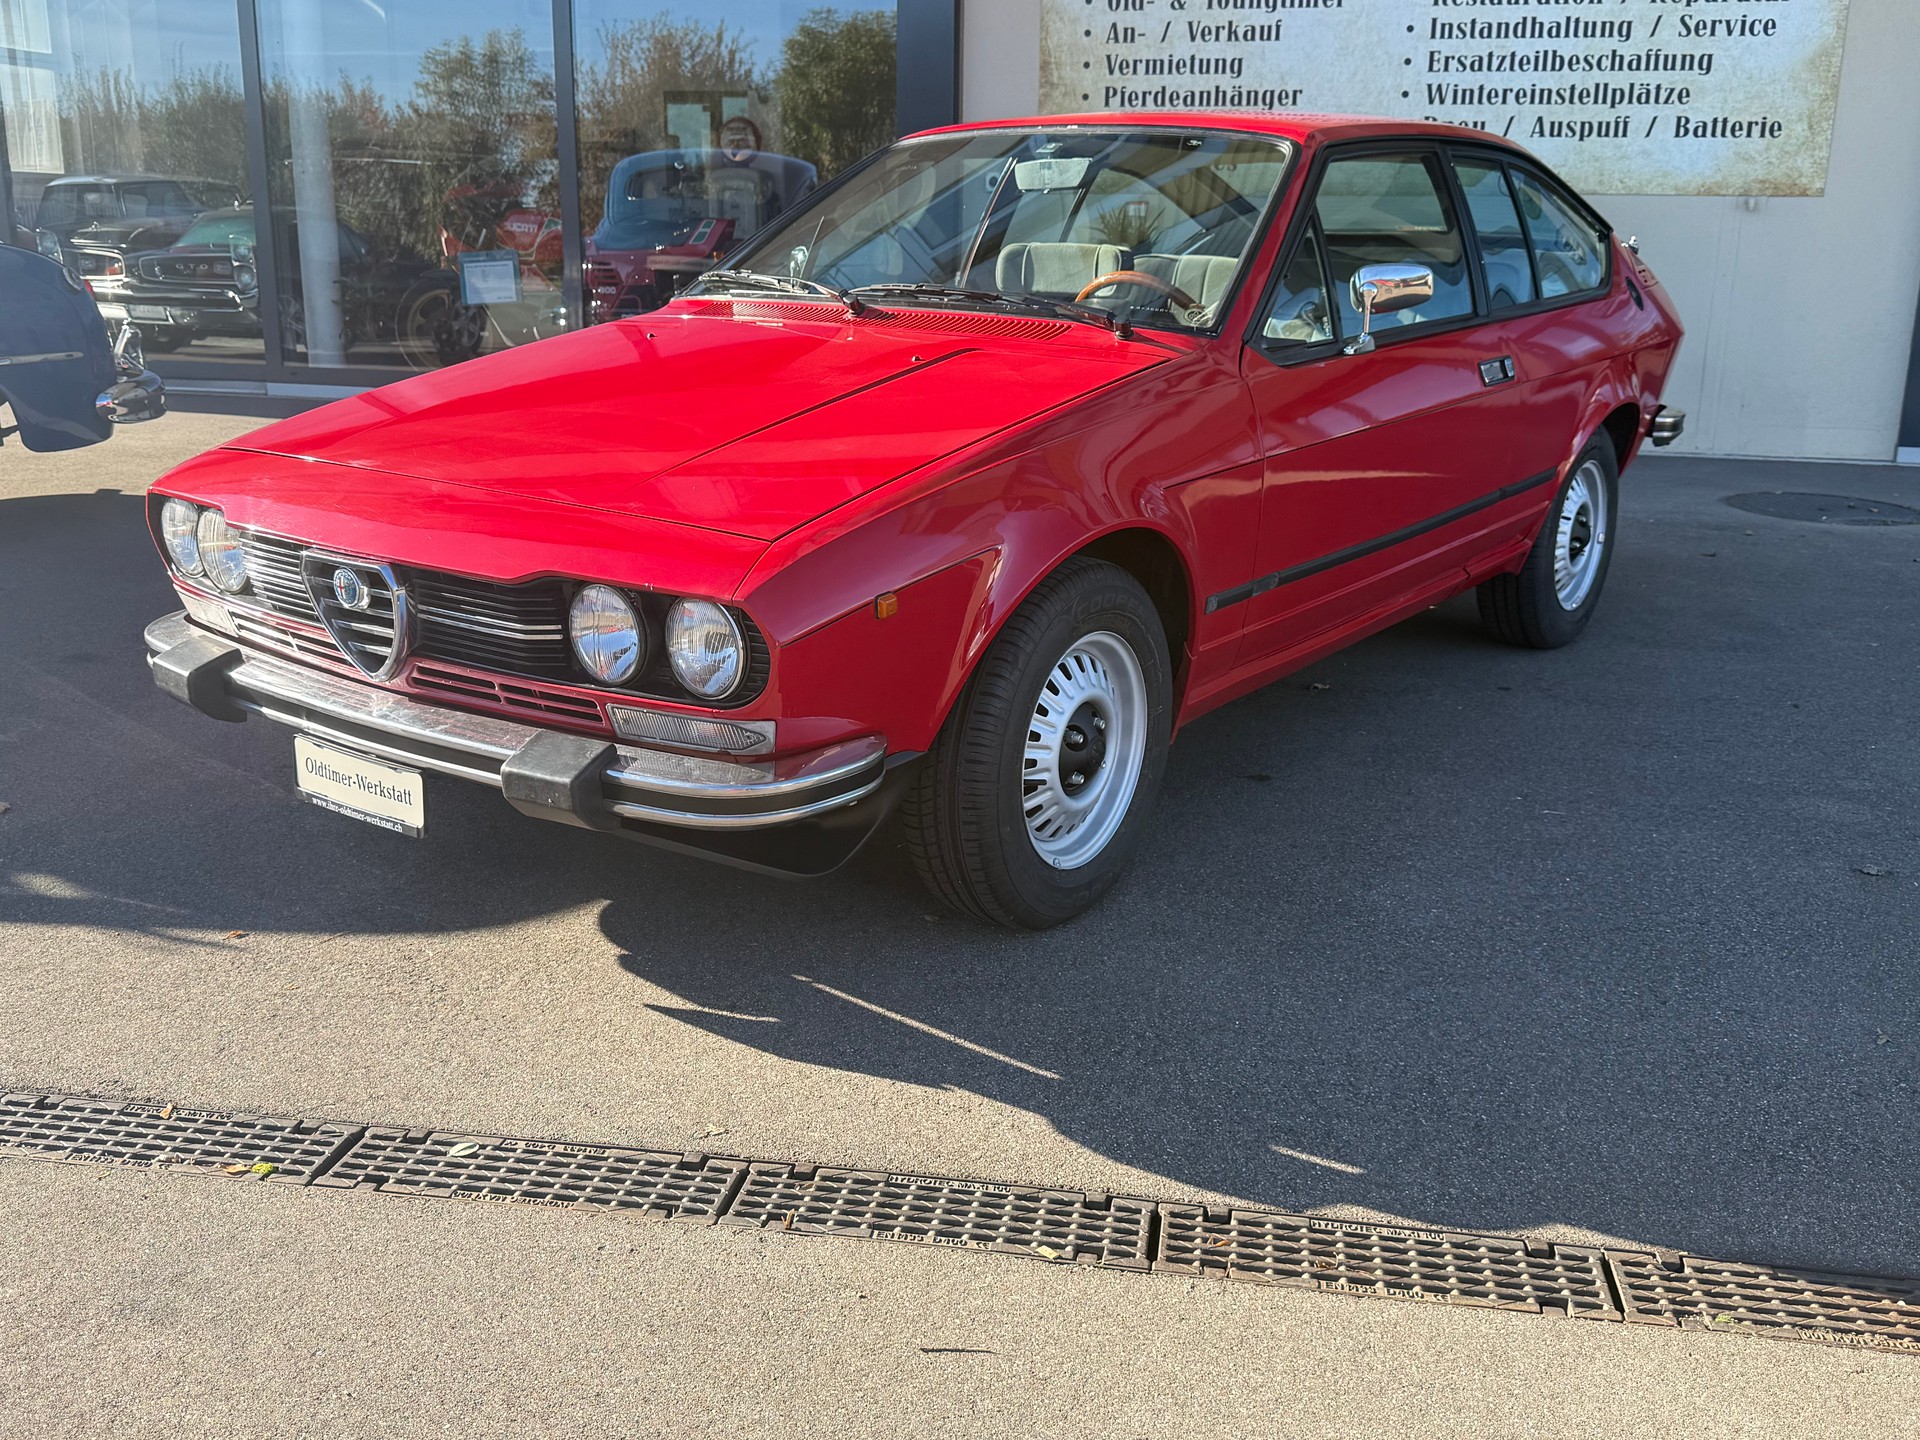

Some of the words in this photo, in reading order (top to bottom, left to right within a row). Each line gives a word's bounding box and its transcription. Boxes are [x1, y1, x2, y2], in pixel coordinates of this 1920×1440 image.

[1105, 22, 1146, 44] An-
[1188, 19, 1283, 43] Verkauf
[1430, 16, 1633, 43] Instandhaltung
[1678, 14, 1777, 38] Service
[1106, 55, 1244, 79] Vermietung
[1427, 49, 1714, 76] Ersatzteilbeschaffung
[1104, 85, 1303, 111] Pferdeanhänger
[1427, 82, 1691, 109] Wintereinstellplätze
[1530, 115, 1631, 142] Auspuff
[1674, 116, 1783, 139] Batterie
[305, 757, 413, 806] Oldtimer-Werkstatt
